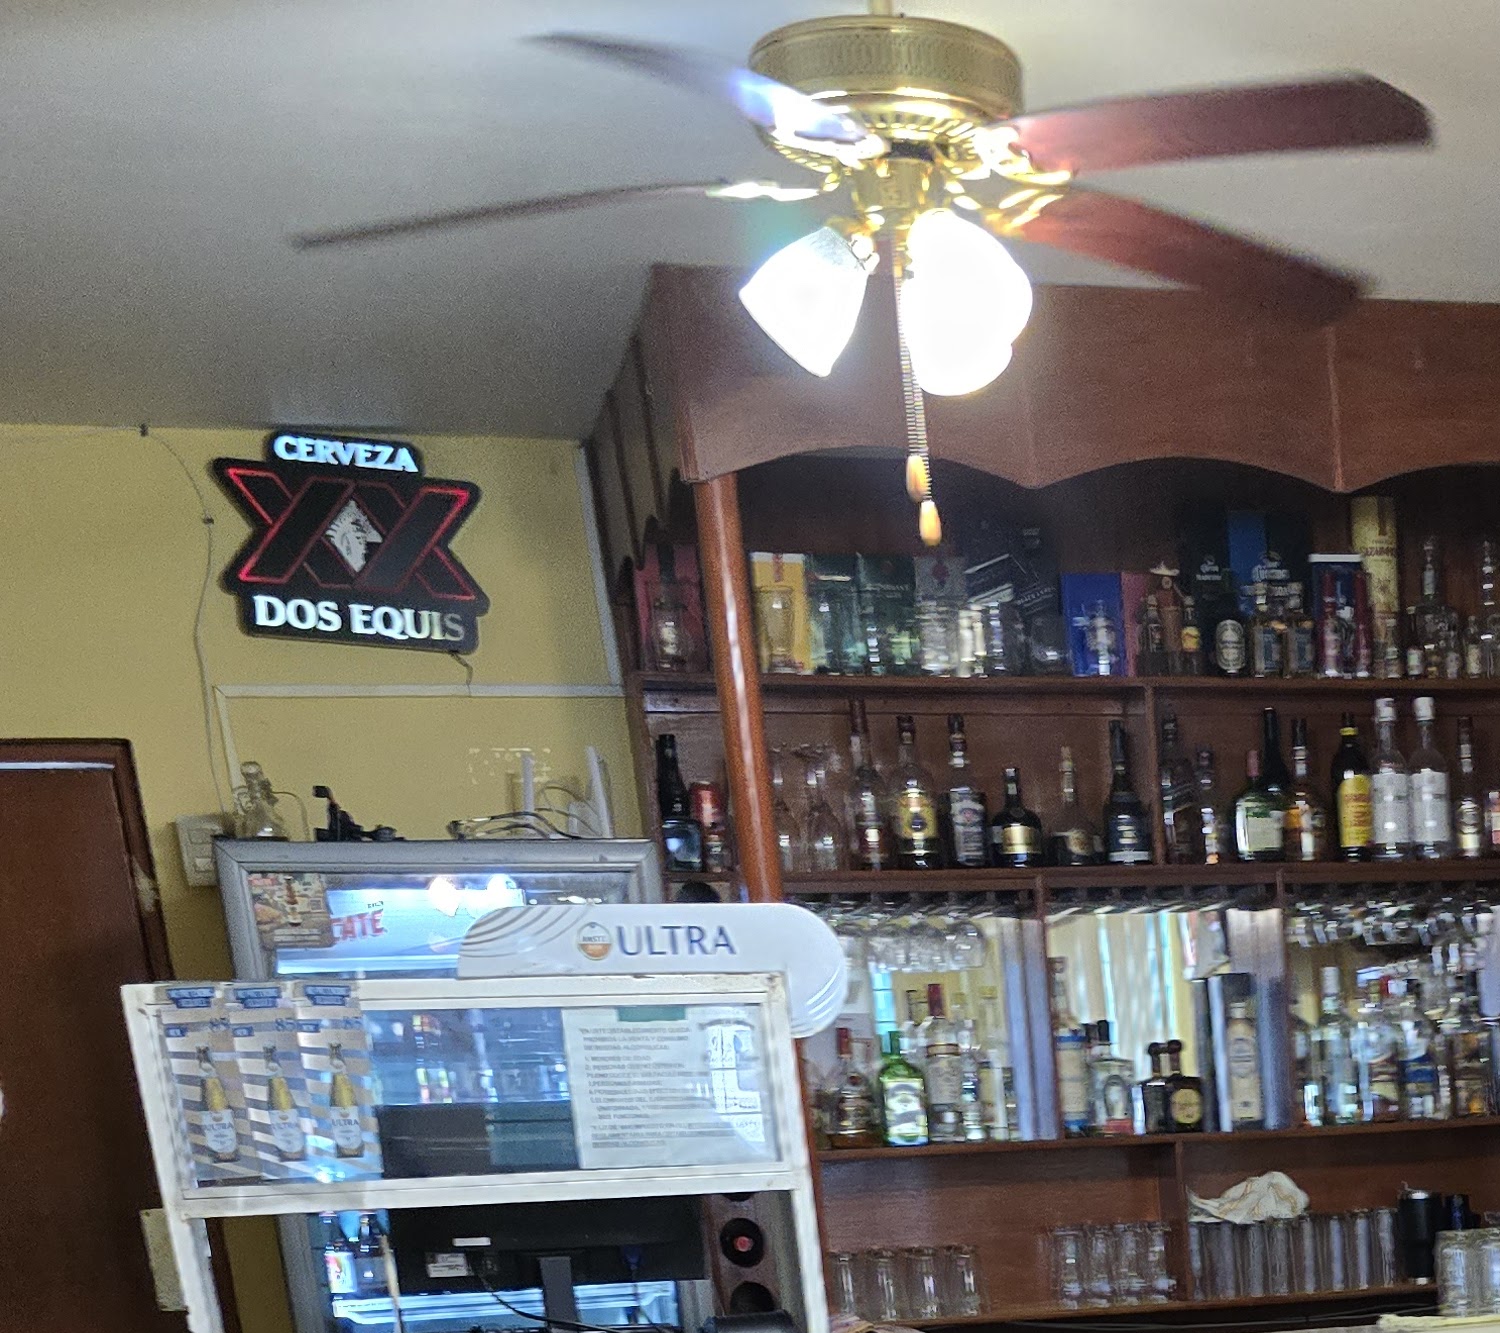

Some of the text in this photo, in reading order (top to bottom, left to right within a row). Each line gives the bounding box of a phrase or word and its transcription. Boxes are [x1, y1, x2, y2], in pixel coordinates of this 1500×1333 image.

[273, 433, 419, 474] CERVEZA
[253, 594, 465, 642] DOS EQUIS
[616, 925, 737, 956] ULTRA
